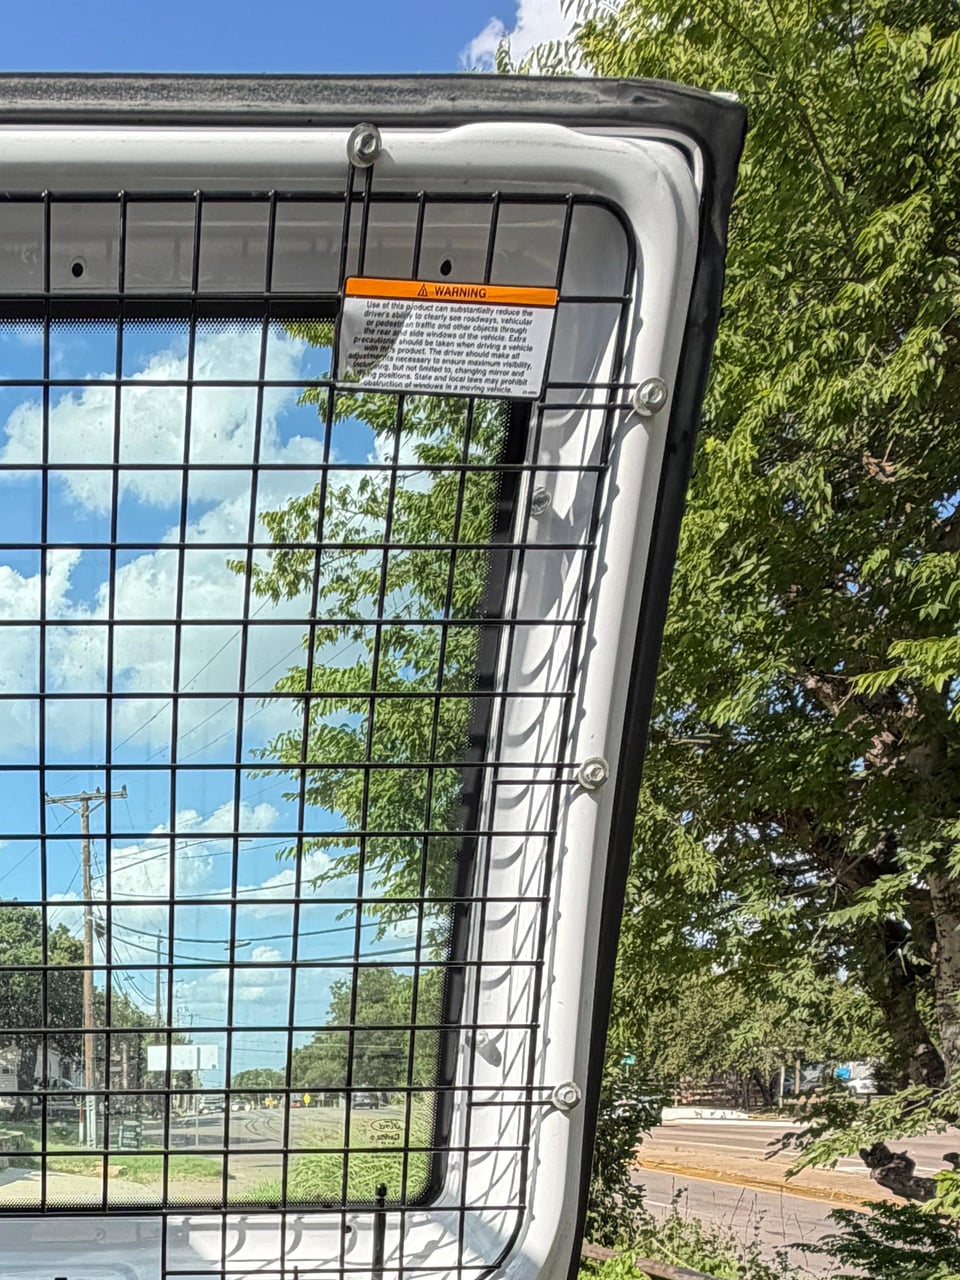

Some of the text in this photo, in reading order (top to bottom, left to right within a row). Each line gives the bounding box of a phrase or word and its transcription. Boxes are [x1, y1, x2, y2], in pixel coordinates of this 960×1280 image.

[434, 286, 486, 298] WARNING
[366, 300, 379, 308] Use
[450, 305, 493, 316] substantially
[495, 308, 519, 316] reduce
[364, 309, 389, 318] driver's
[423, 313, 446, 322] clearly
[463, 315, 498, 324] roadways,
[500, 317, 532, 325] vehicular
[415, 321, 435, 329] traffic
[452, 323, 470, 331] other
[472, 324, 498, 333] objects
[500, 326, 527, 335] through
[426, 331, 456, 339] windows
[397, 346, 426, 355] product.
[490, 351, 509, 359] make
[476, 342, 500, 351] driving
[508, 343, 532, 351] vehicle
[395, 356, 430, 364] necessary
[467, 359, 500, 367] maximum
[418, 365, 442, 373] limited
[454, 367, 487, 376] changing
[414, 373, 432, 381] State
[500, 378, 527, 387] prohibit
[459, 384, 484, 393] moving
[486, 385, 512, 393] vehicle.
